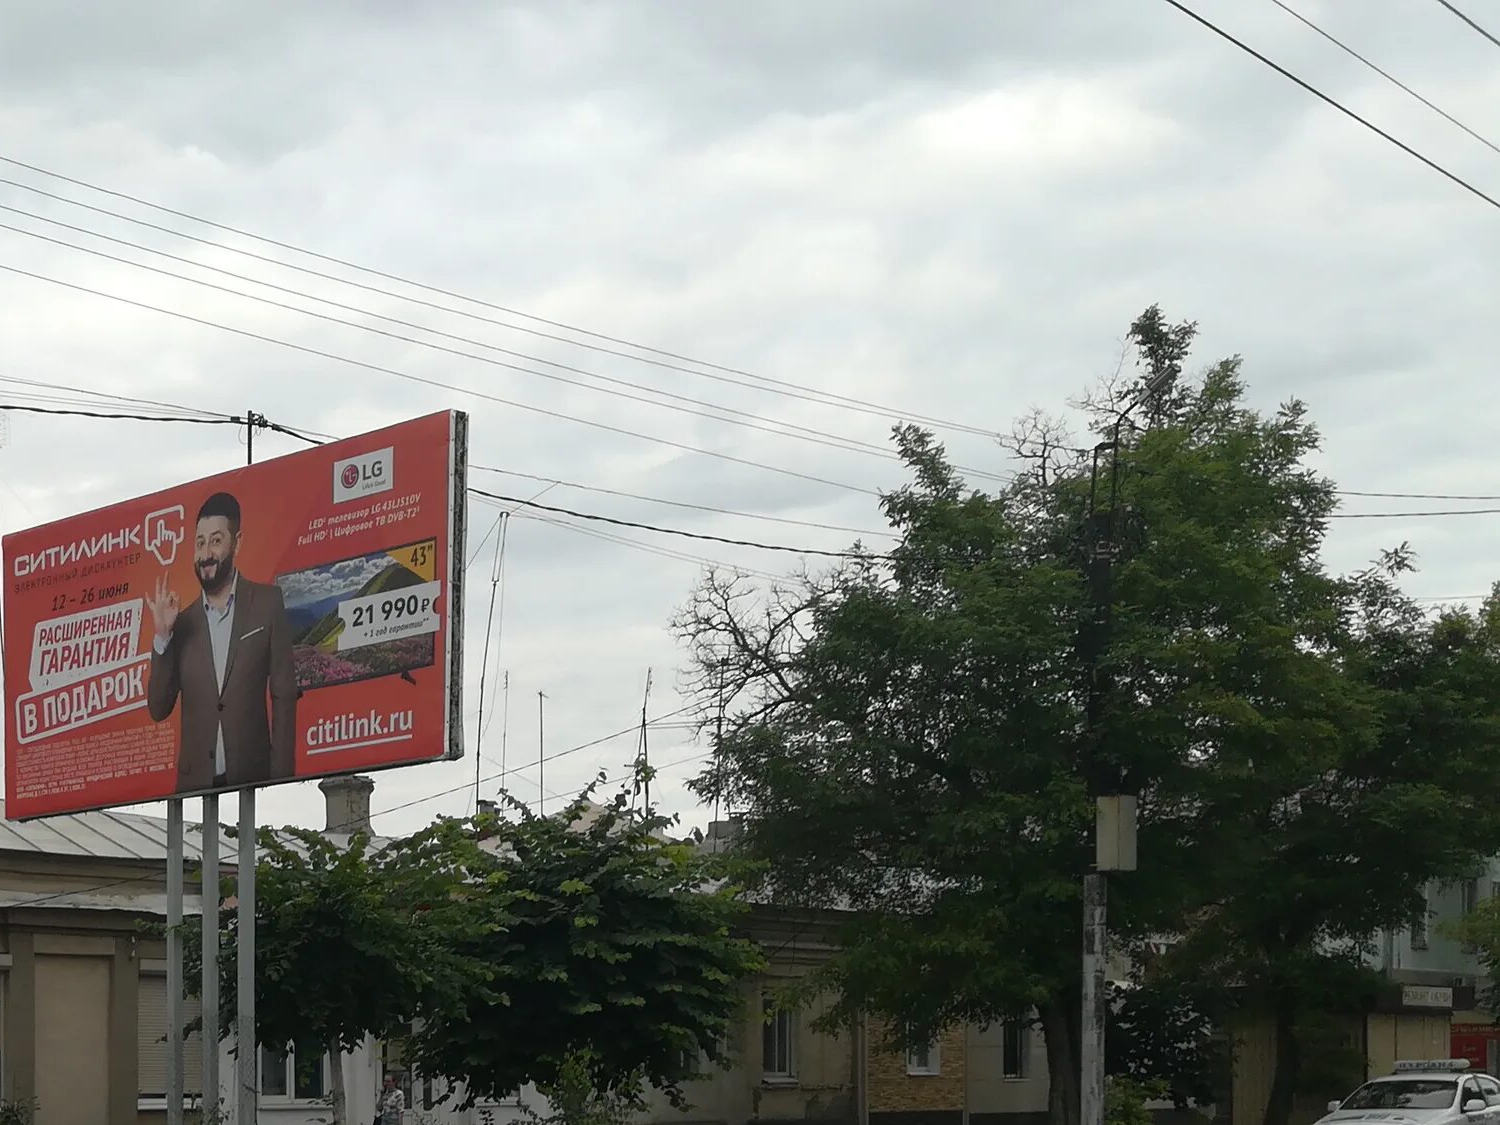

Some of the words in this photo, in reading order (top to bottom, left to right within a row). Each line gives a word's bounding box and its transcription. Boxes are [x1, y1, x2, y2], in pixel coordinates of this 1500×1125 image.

[362, 460, 383, 480] LG
[327, 508, 370, 526] телевизор
[371, 503, 381, 515] LG
[297, 534, 313, 546] Full
[334, 520, 374, 537] Цифровое
[14, 524, 141, 577] СИТИЛИНК
[13, 569, 78, 594] ЭЛЕКТРОННЫЙ
[81, 552, 141, 578] ДИСКАУНТЕР
[52, 593, 66, 612] 12
[79, 587, 95, 606] 26
[98, 582, 129, 601] июня
[352, 604, 374, 628] 21
[381, 594, 419, 621] 990
[38, 608, 133, 647] РАСШИРЕННАЯ
[39, 631, 131, 677] ГАРАНТИЯ
[24, 703, 38, 734] В
[306, 709, 413, 746] citilink.ru
